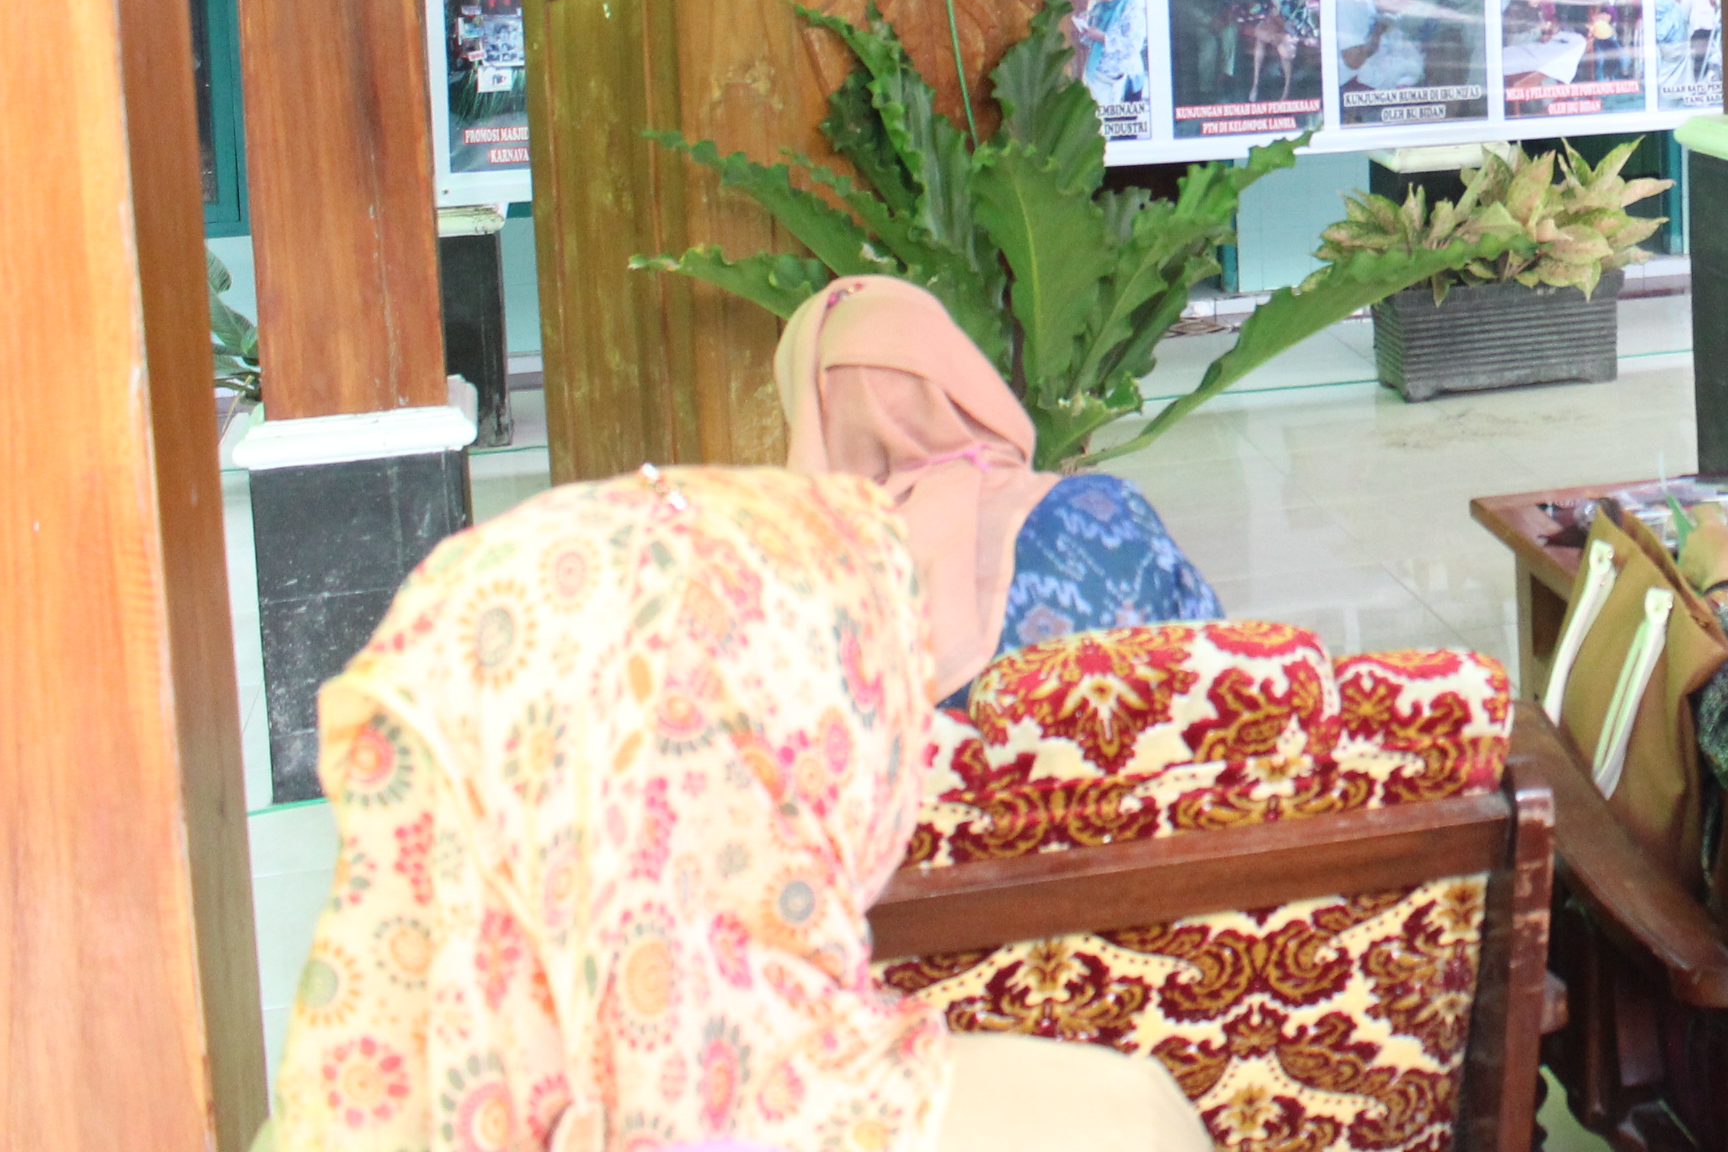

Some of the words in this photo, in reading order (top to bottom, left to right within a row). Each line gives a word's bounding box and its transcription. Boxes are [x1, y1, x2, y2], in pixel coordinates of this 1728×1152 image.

[1345, 92, 1397, 106] KUNJUNGAN
[1399, 90, 1428, 102] RUMAH
[1097, 101, 1145, 116] EMBINAAN
[1175, 105, 1222, 120] KUNJUNGAN
[1223, 104, 1250, 117] RUMAH
[1251, 103, 1267, 115] DAN
[1267, 99, 1321, 114] PEMERIKSAAN
[1383, 110, 1405, 120] OLEH
[1419, 107, 1444, 118] BIDAN
[1103, 121, 1148, 135] INDUSTRI
[1229, 119, 1268, 132] KELOMPOK
[465, 128, 500, 144] PROMOSI
[490, 148, 530, 163] KARNAVA
